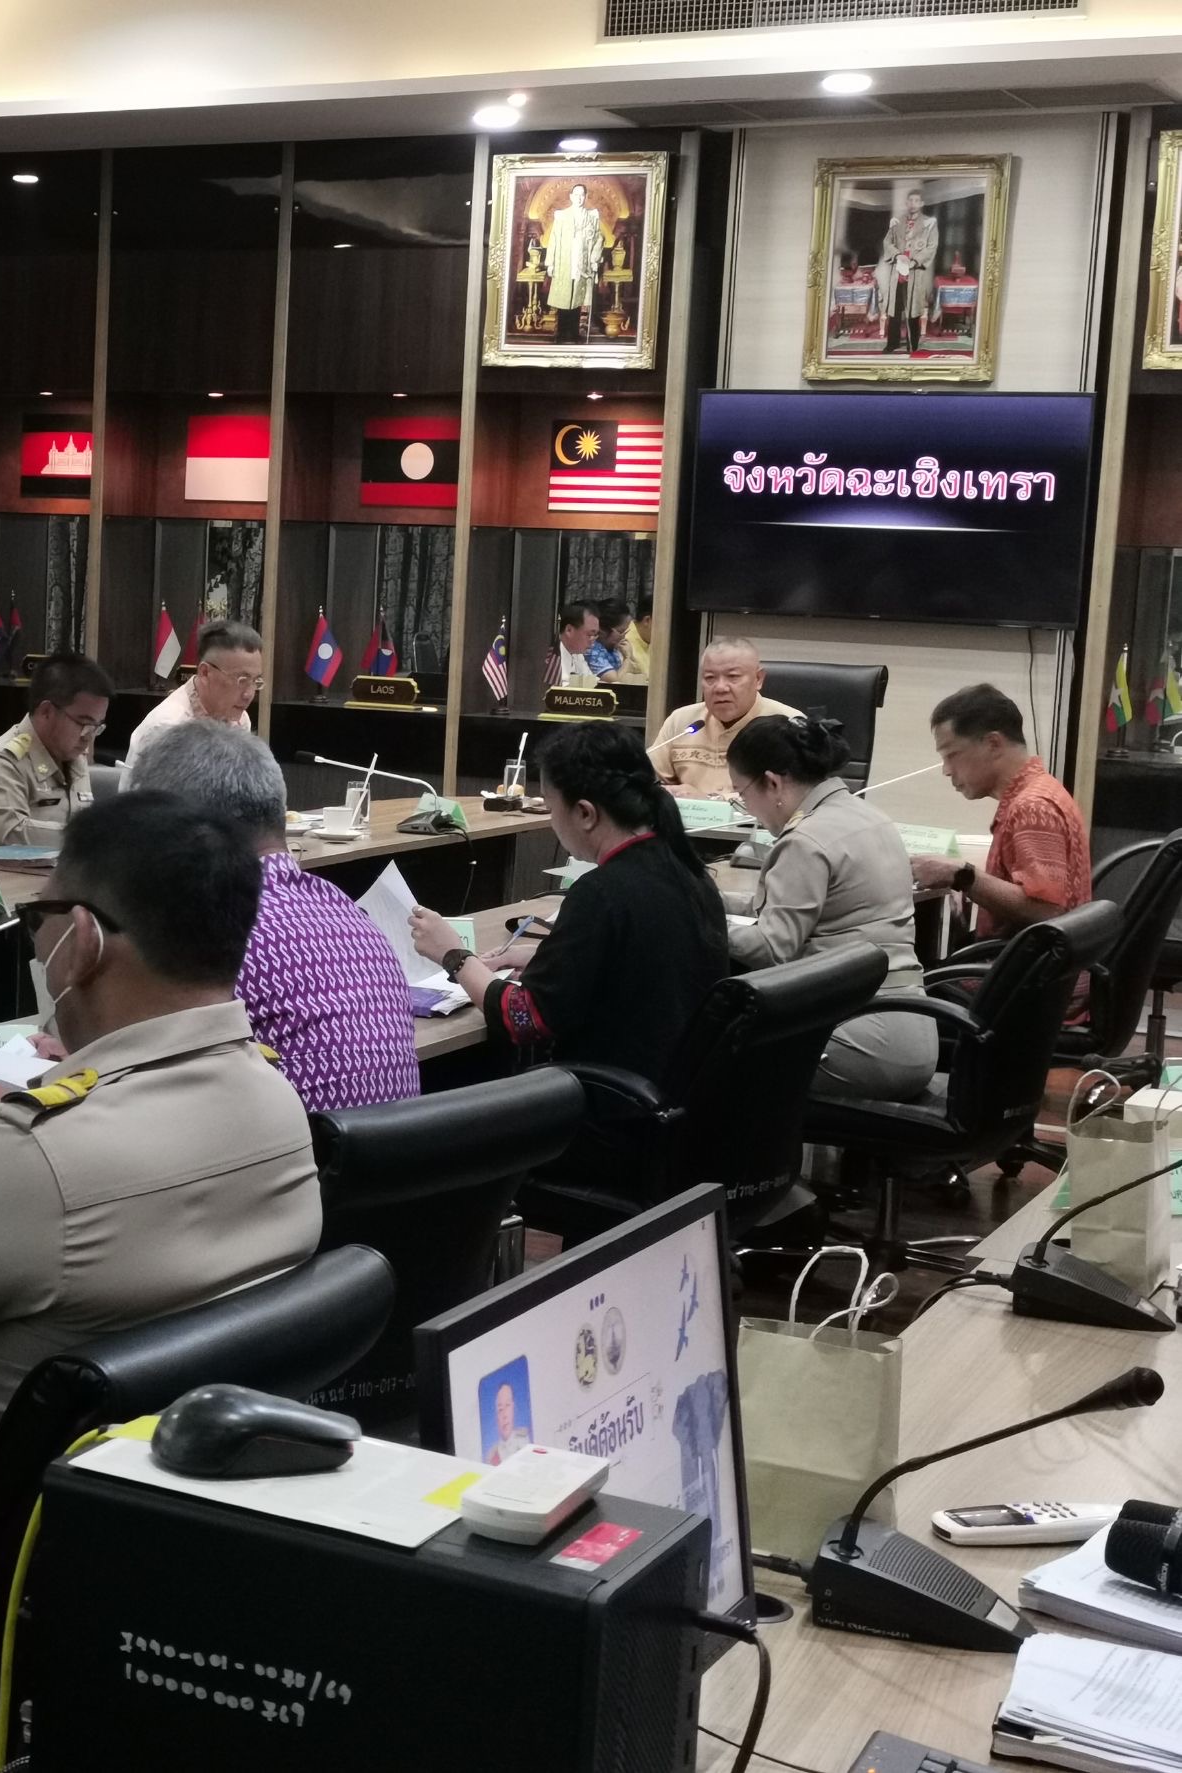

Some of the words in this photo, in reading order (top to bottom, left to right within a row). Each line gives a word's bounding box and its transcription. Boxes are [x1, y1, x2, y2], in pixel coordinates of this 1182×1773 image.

[723, 451, 1056, 502] จังหวัดฉะเชิงเทรา
[370, 684, 395, 695] LAOS
[554, 695, 603, 707] MALAYSIA
